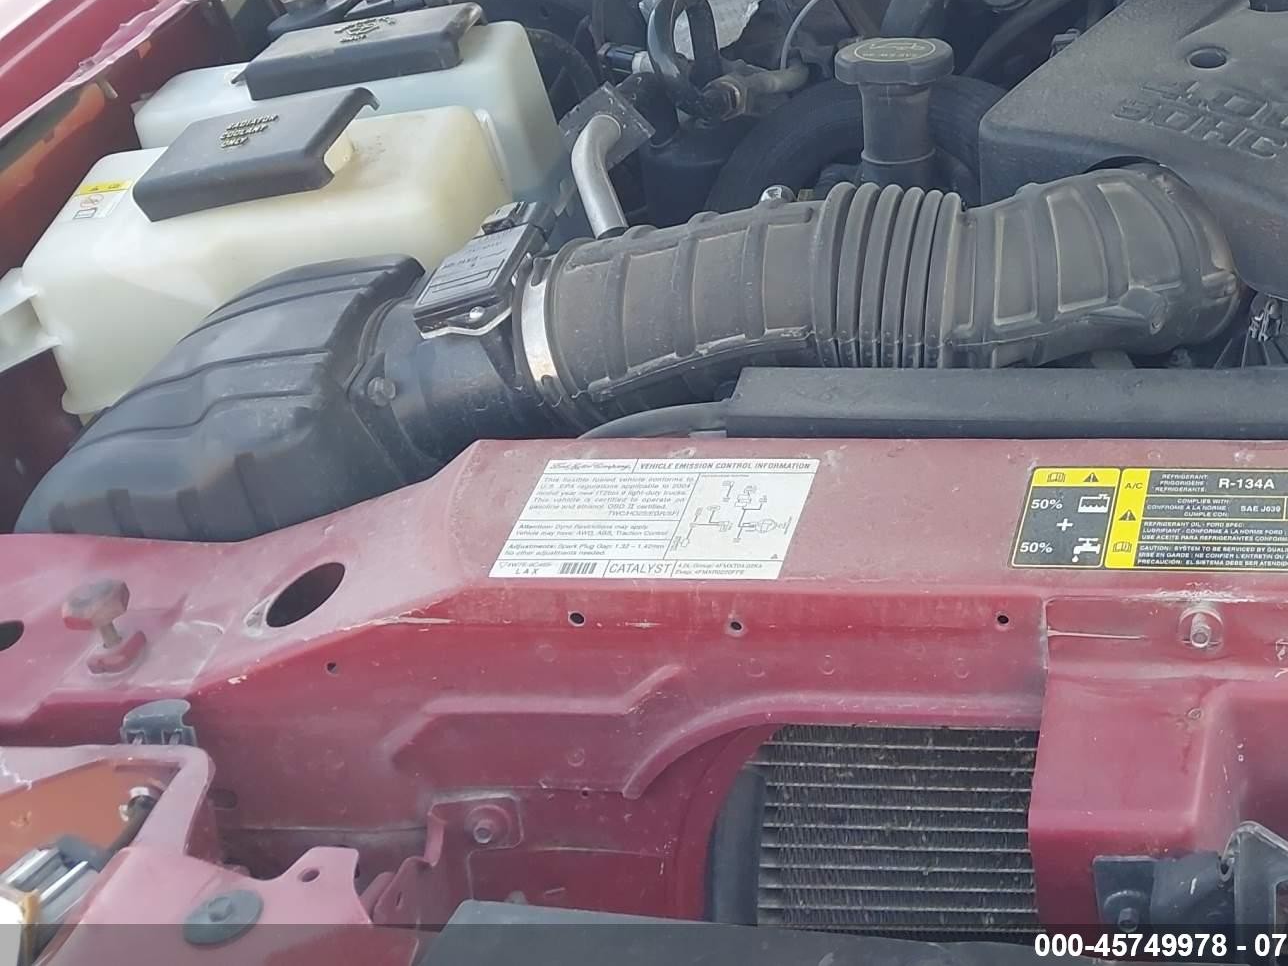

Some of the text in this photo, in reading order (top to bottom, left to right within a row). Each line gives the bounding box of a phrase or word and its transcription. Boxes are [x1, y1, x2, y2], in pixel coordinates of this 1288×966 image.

[226, 115, 279, 131] RADIATOR
[1112, 98, 1287, 159] SOHC
[221, 136, 249, 149] ONLY
[1124, 481, 1143, 490] A/C
[1218, 478, 1275, 490] R-134A
[1031, 498, 1063, 510] 50%
[1020, 542, 1053, 554] 50%
[609, 563, 673, 574] CATALYST
